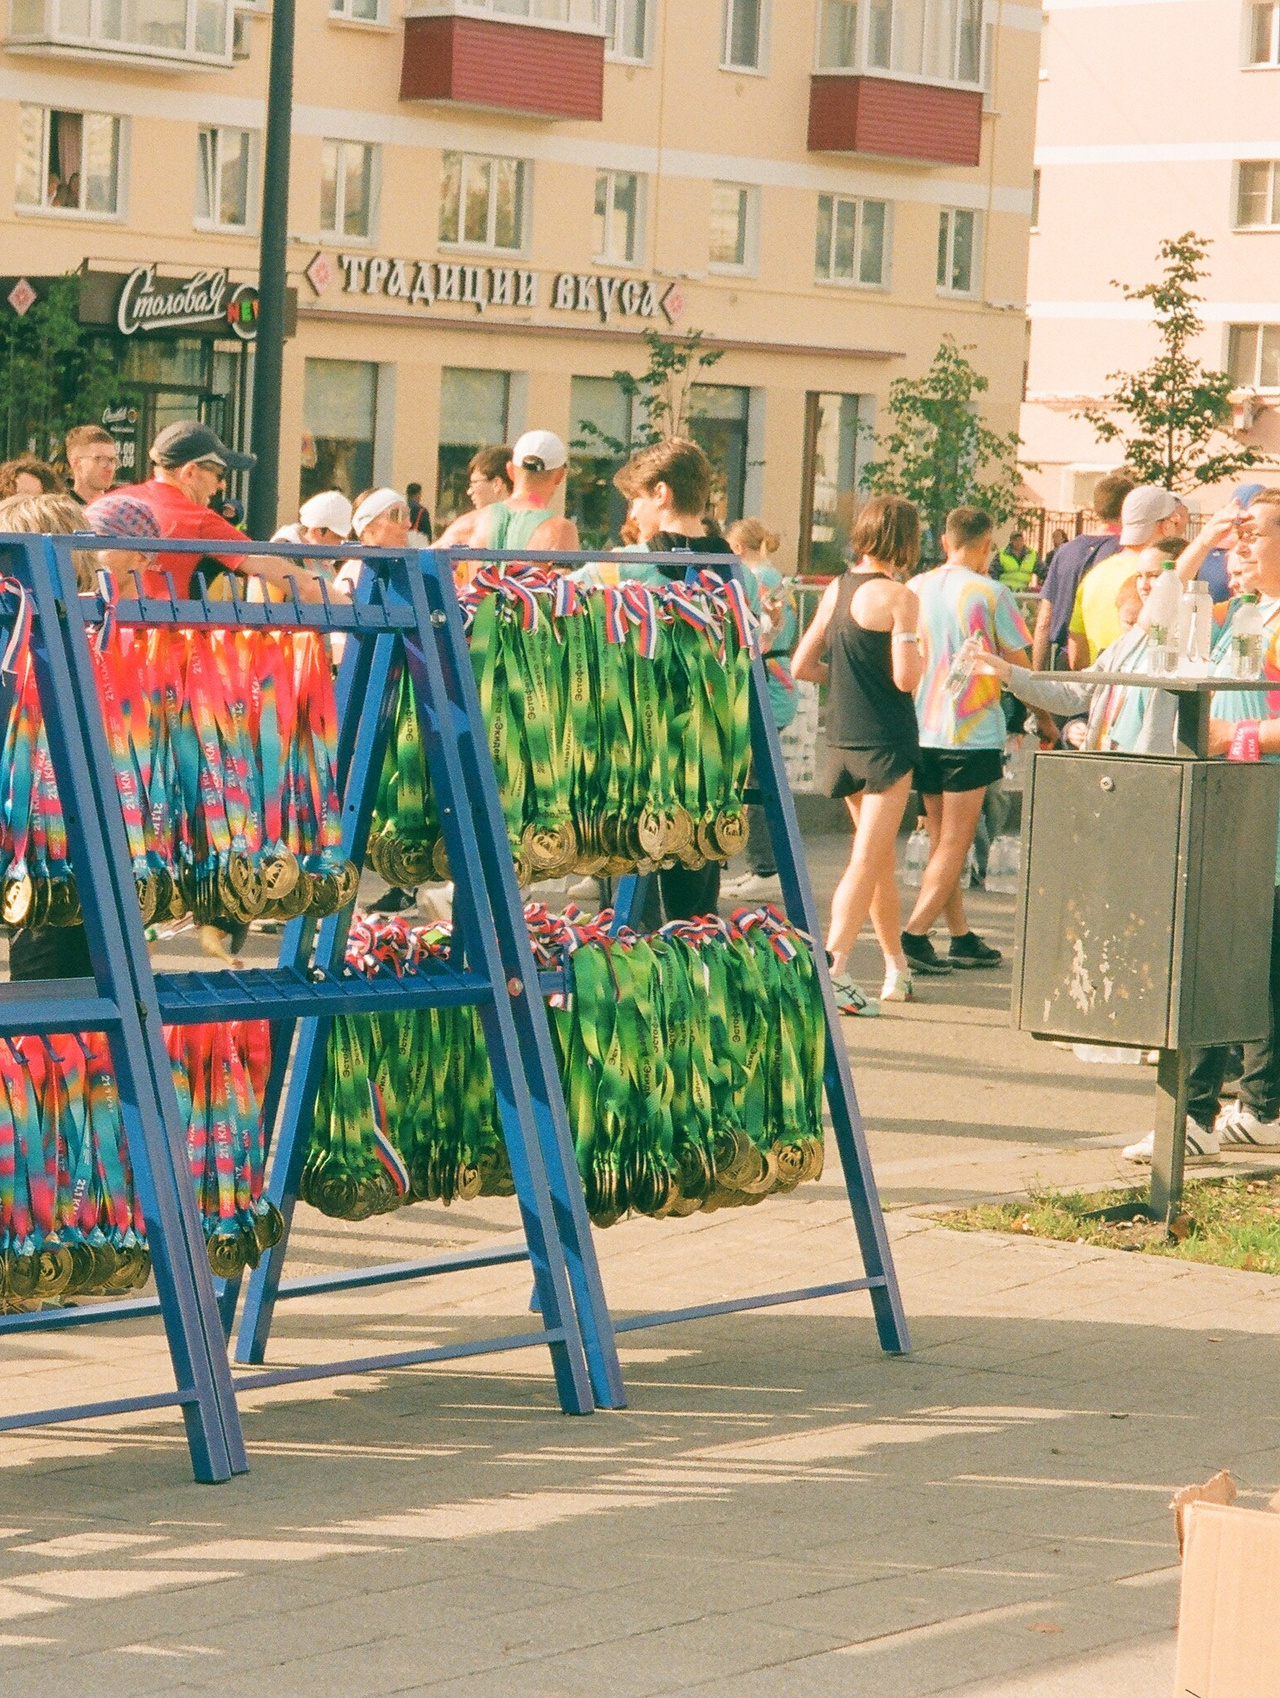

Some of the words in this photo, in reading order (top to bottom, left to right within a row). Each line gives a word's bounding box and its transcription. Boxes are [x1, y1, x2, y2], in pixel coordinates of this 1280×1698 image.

[118, 266, 226, 335] Столовая
[339, 254, 538, 313] ТРАДИЦИИ
[551, 274, 658, 324] ВКУСА
